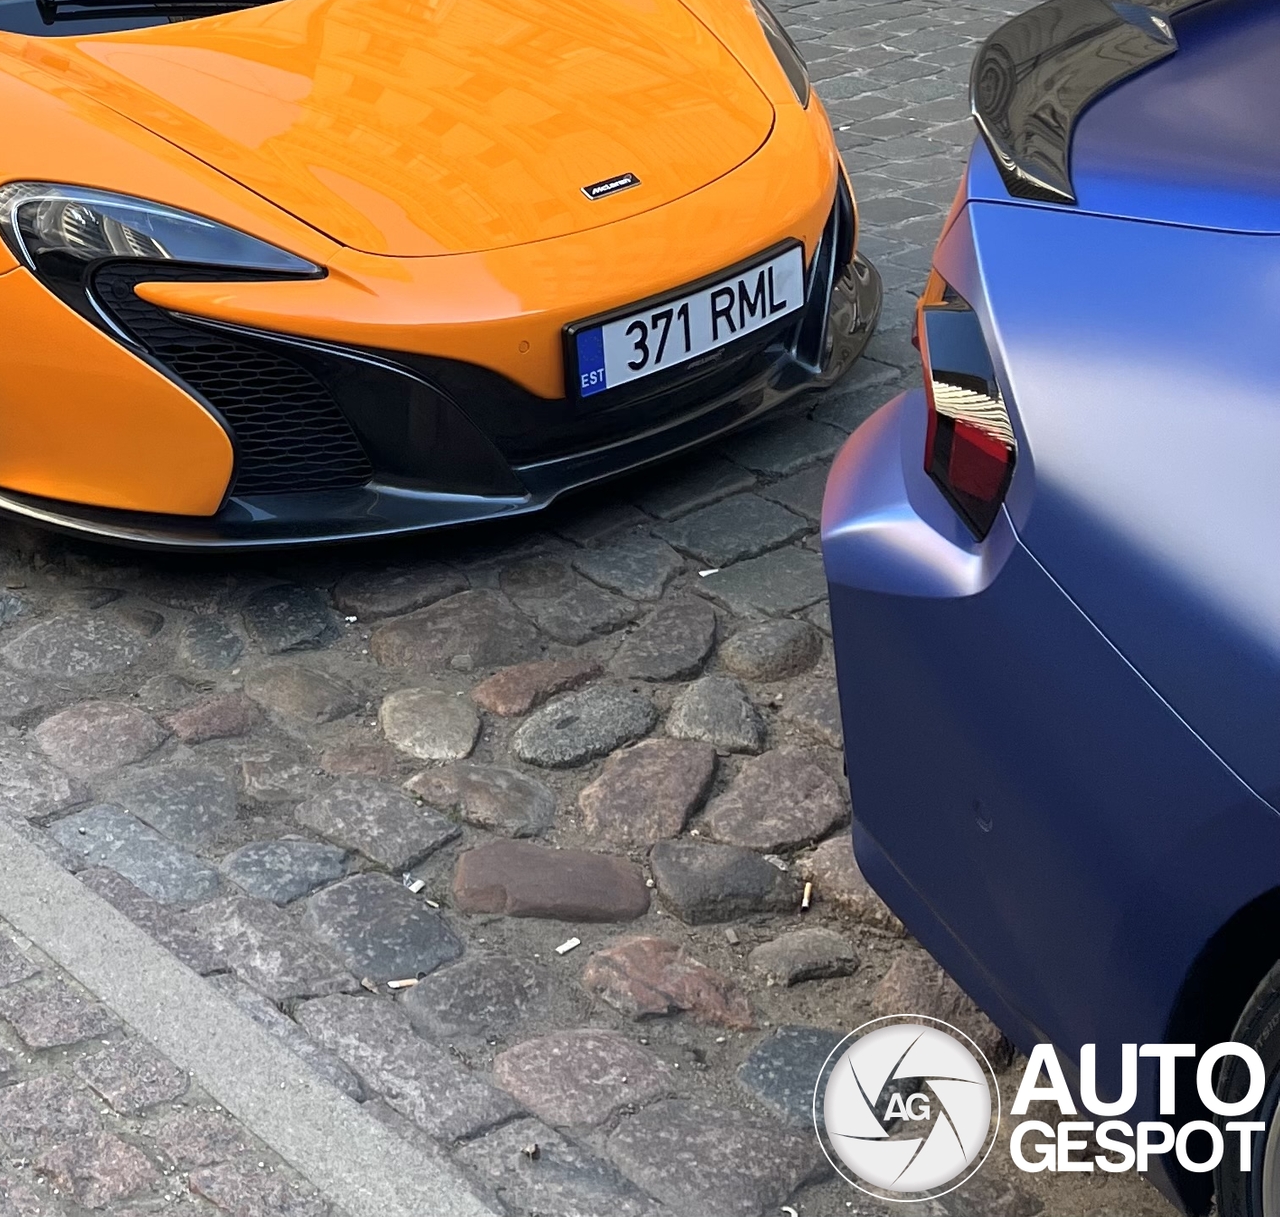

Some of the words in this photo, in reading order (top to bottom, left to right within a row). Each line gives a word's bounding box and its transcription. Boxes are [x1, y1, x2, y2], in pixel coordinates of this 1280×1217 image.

[625, 302, 692, 371] 371
[711, 266, 787, 342] RML
[581, 368, 605, 388] EST
